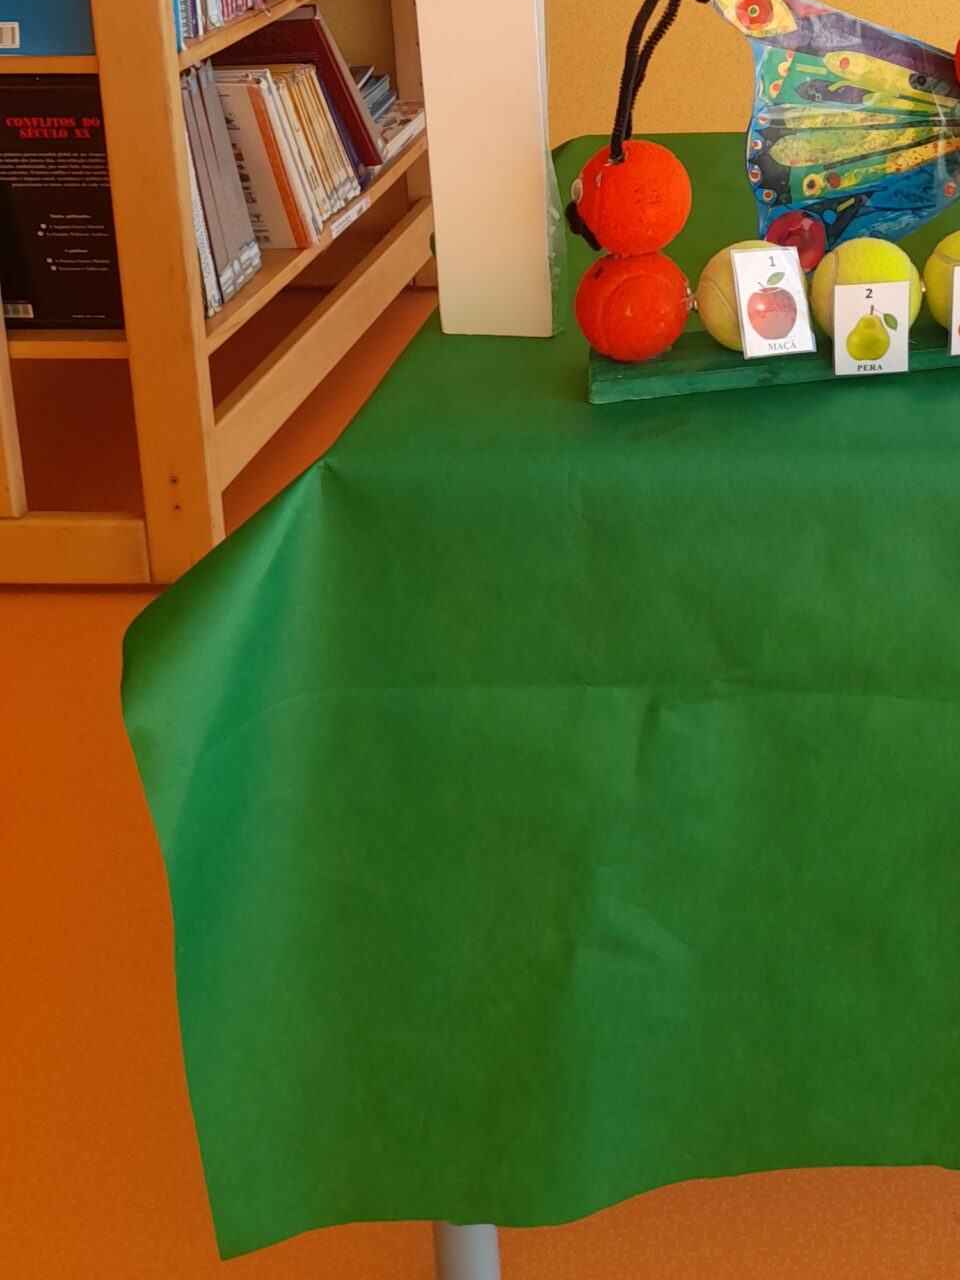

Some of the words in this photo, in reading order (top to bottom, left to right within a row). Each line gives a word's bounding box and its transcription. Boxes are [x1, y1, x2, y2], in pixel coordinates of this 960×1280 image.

[5, 117, 76, 128] CONFLITOS
[82, 117, 100, 128] DO
[74, 128, 91, 138] XX
[768, 256, 776, 266] 1
[866, 288, 873, 298] 2
[768, 340, 797, 352] MAÇÃ
[857, 364, 883, 372] PERA
